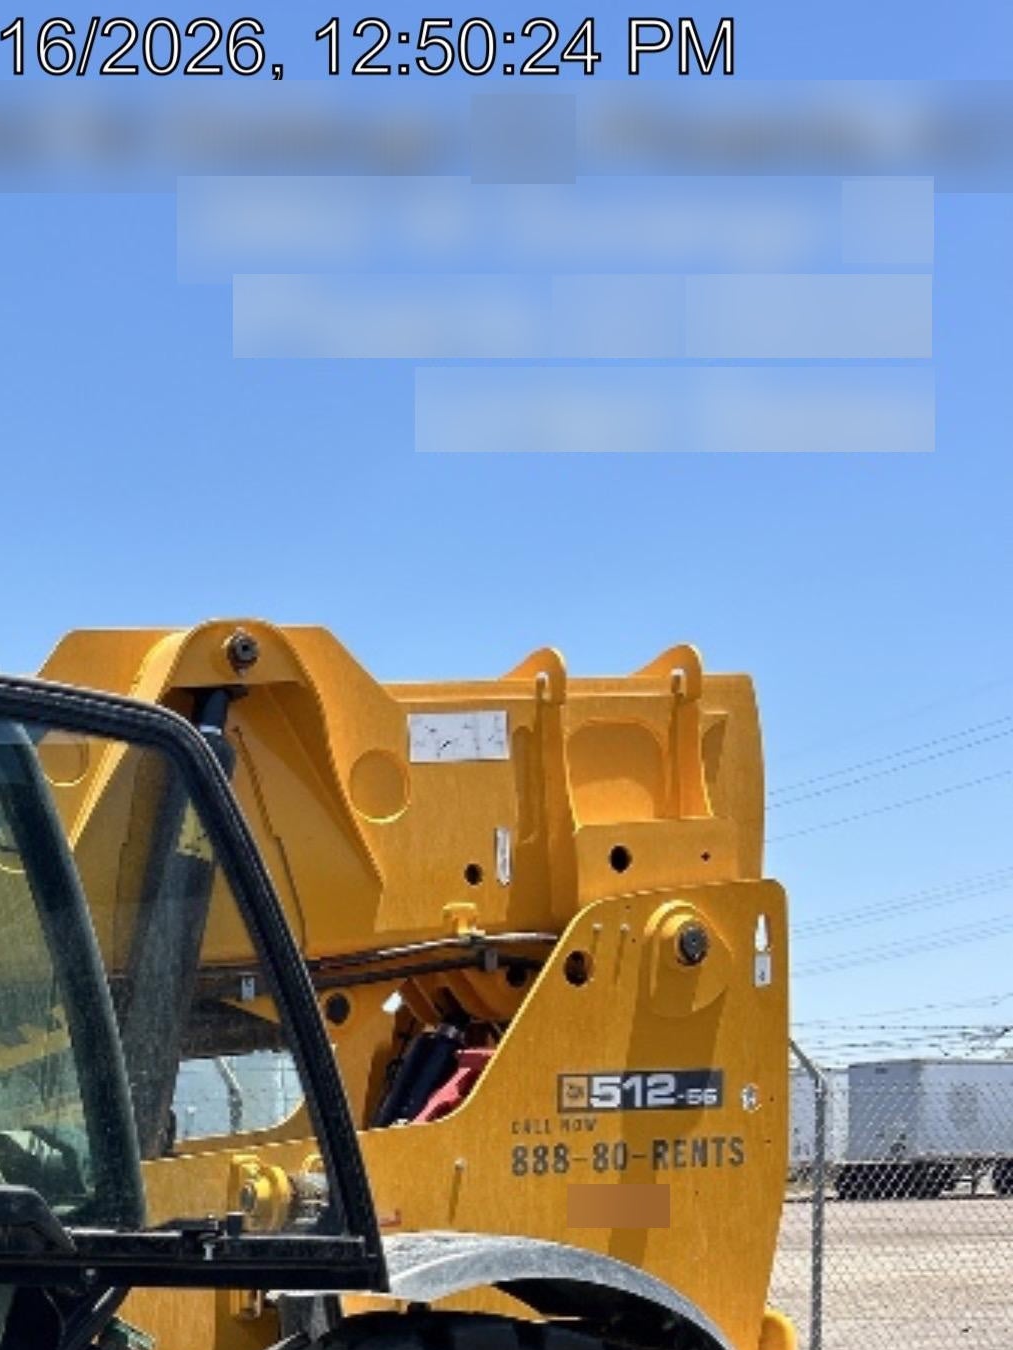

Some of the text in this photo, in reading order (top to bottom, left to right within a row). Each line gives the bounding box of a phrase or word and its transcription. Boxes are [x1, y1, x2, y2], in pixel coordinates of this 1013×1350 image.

[511, 1117, 598, 1135] CALL NOW
[511, 1136, 745, 1177] 888-80-RENTS
